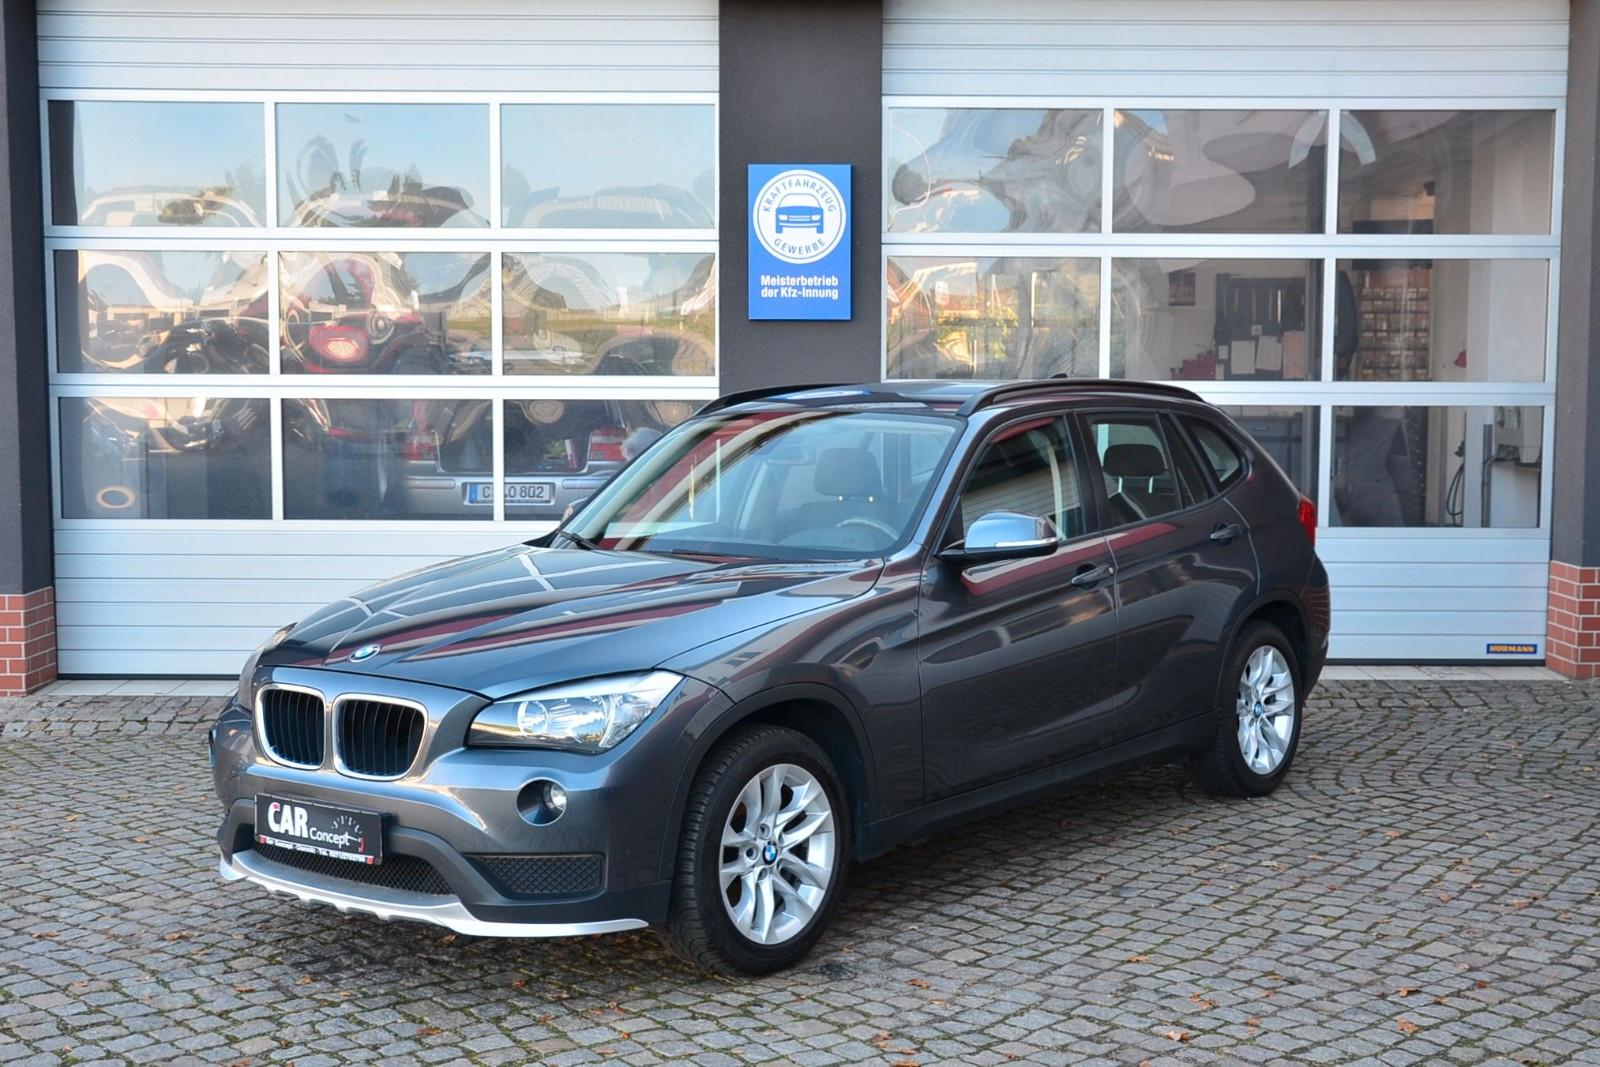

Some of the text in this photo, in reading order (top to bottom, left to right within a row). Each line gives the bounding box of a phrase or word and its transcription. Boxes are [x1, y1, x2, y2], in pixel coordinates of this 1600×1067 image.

[763, 178, 837, 213] KRAFTFAHRZEUG
[773, 237, 827, 256] GEWERBE
[760, 274, 839, 286] Meisterbetrieb
[761, 287, 839, 300] der Kfz-Innung
[519, 486, 544, 498] 802
[268, 802, 351, 849] CAR Concept
